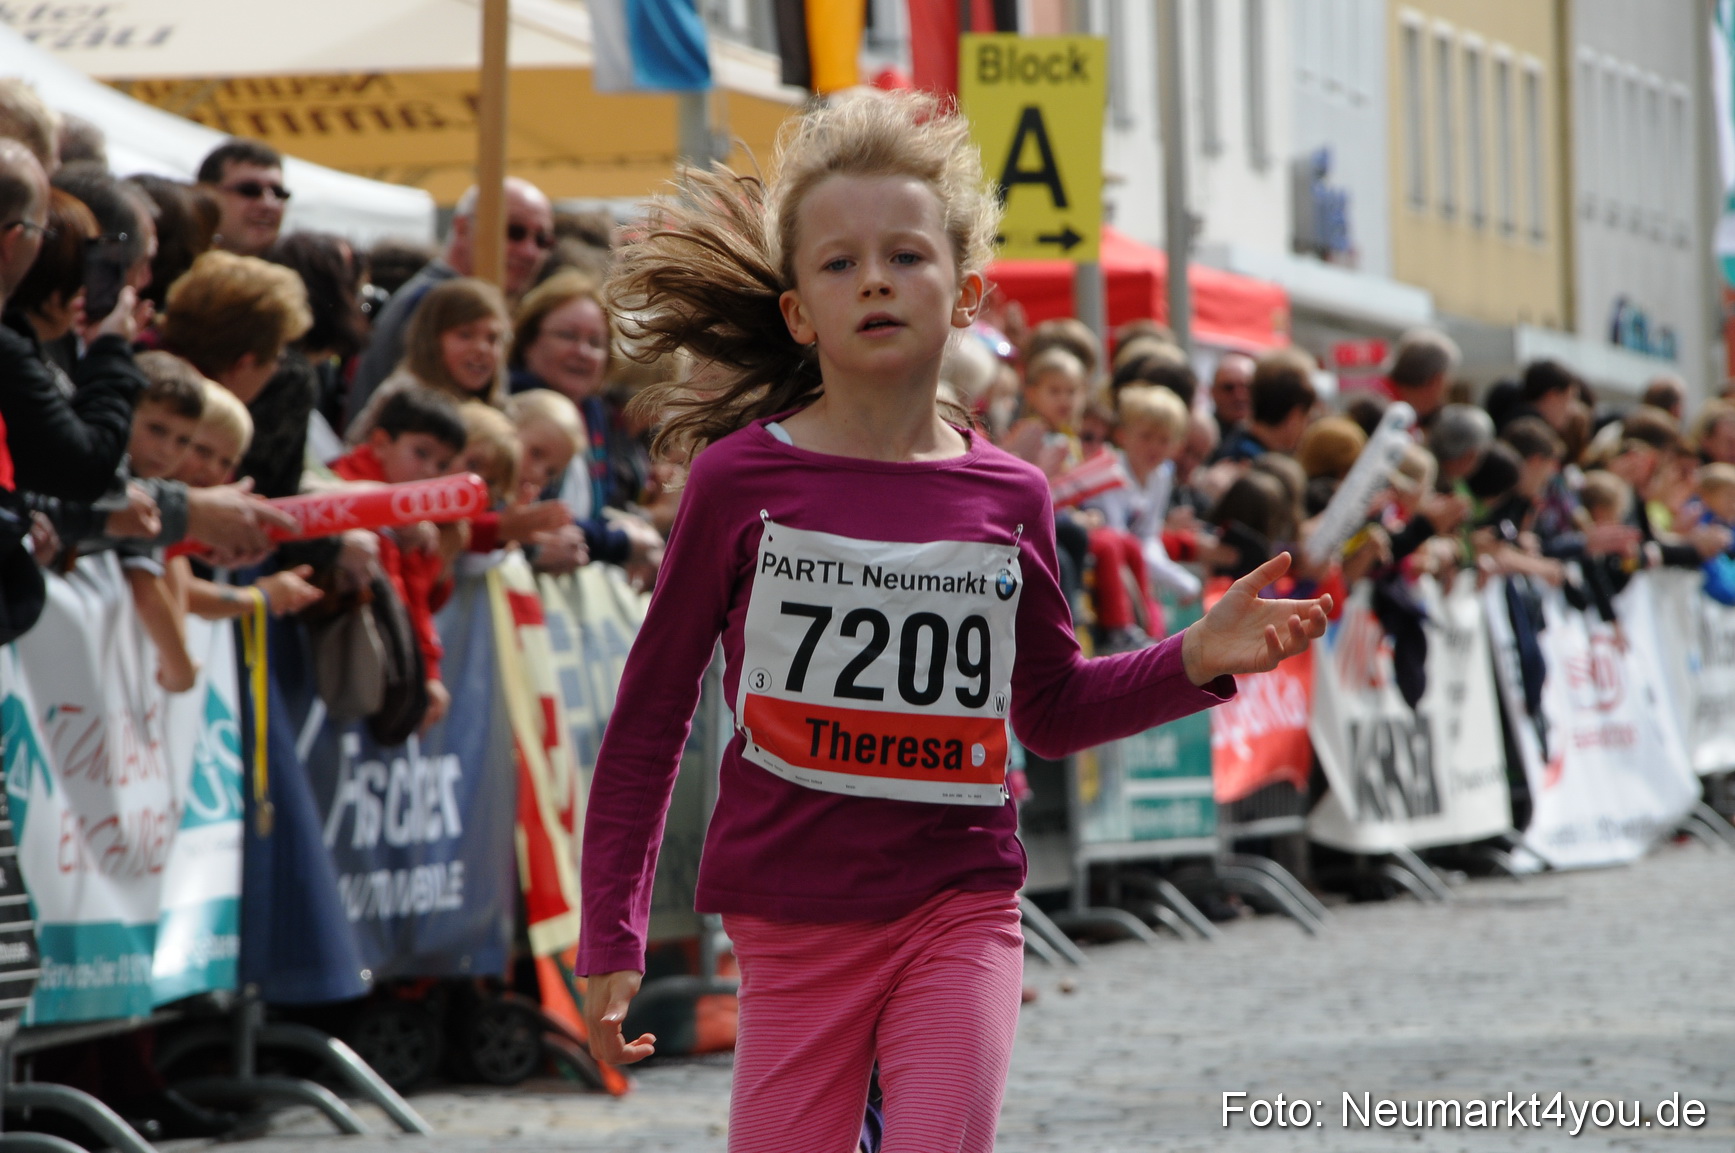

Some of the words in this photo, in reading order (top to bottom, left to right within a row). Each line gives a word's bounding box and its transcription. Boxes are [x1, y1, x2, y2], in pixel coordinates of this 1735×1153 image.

[976, 44, 1090, 84] Block
[997, 106, 1068, 208] A
[761, 551, 853, 586] PARTL
[862, 564, 987, 595] Neumarkt
[780, 600, 991, 708] 7209
[755, 672, 765, 689] 3
[995, 696, 1005, 712] W
[805, 717, 963, 770] Theresa
